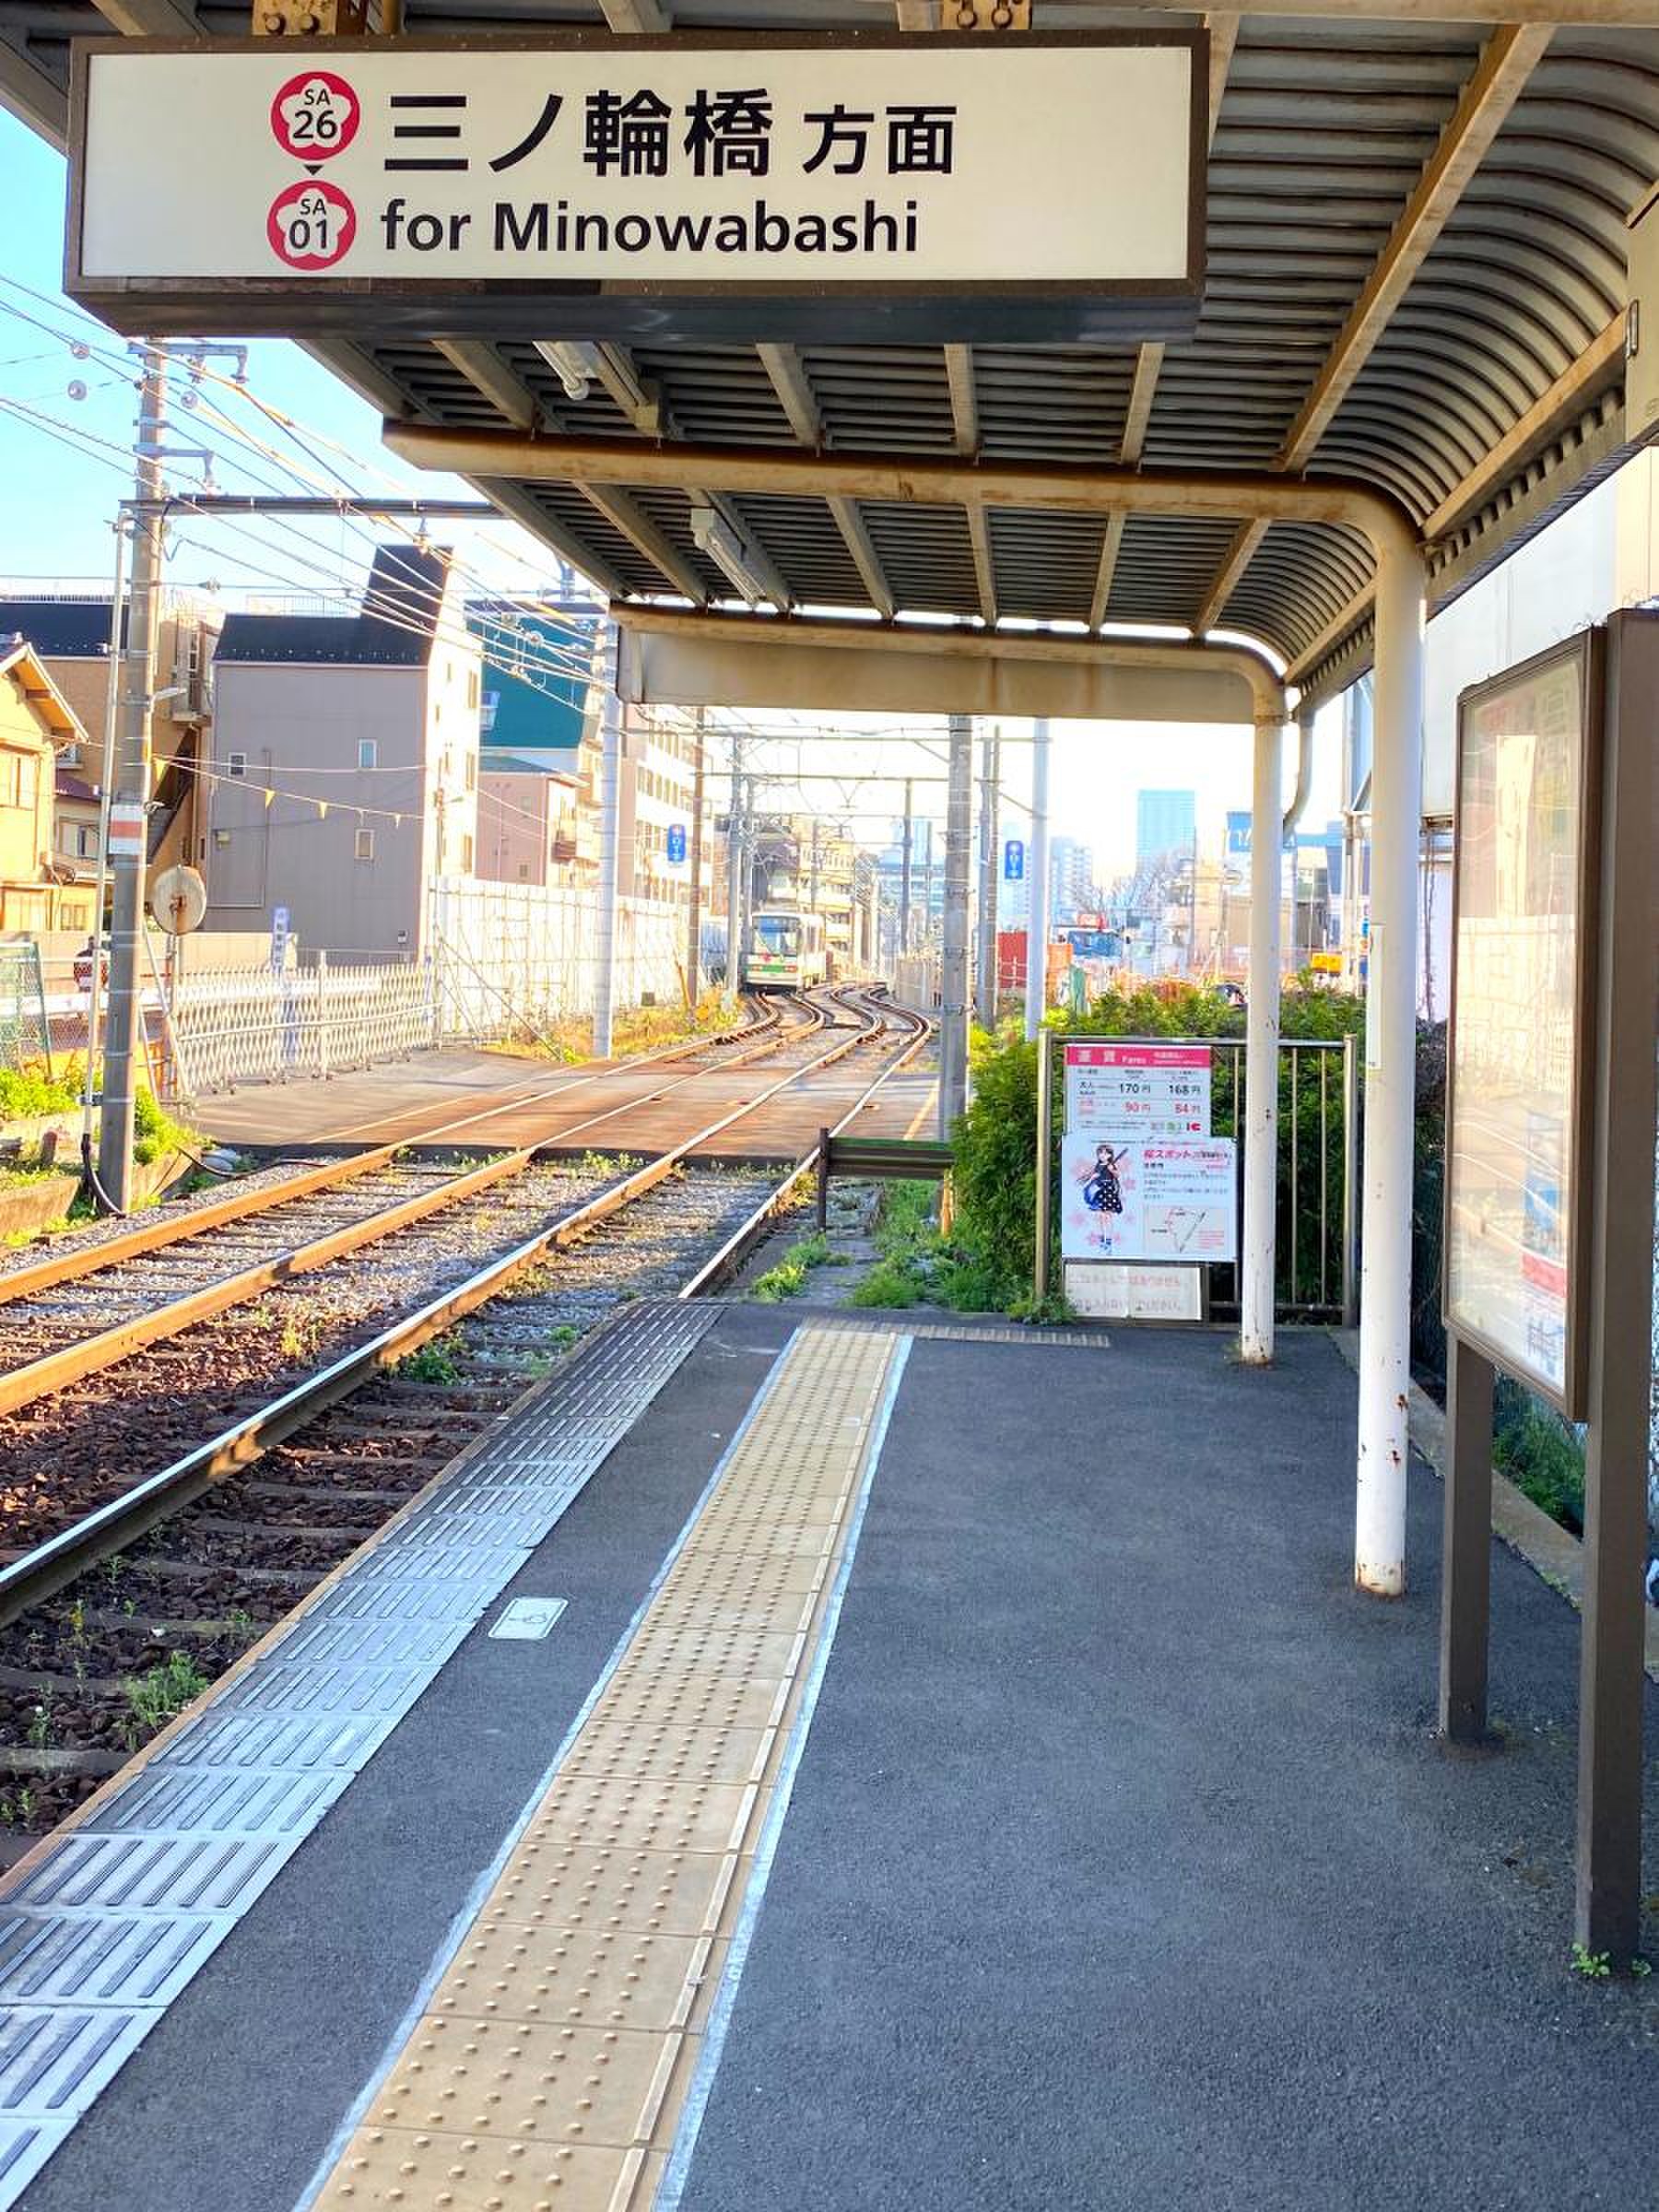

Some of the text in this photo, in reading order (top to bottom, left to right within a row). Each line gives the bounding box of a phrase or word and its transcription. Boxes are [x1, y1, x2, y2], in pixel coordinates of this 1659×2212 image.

[304, 88, 331, 105] SA
[292, 110, 337, 139] 26
[383, 88, 958, 177] 三ノ輪橋 方面
[300, 198, 327, 215] SA
[288, 219, 328, 250] 01
[380, 198, 917, 252] for Minowabashi
